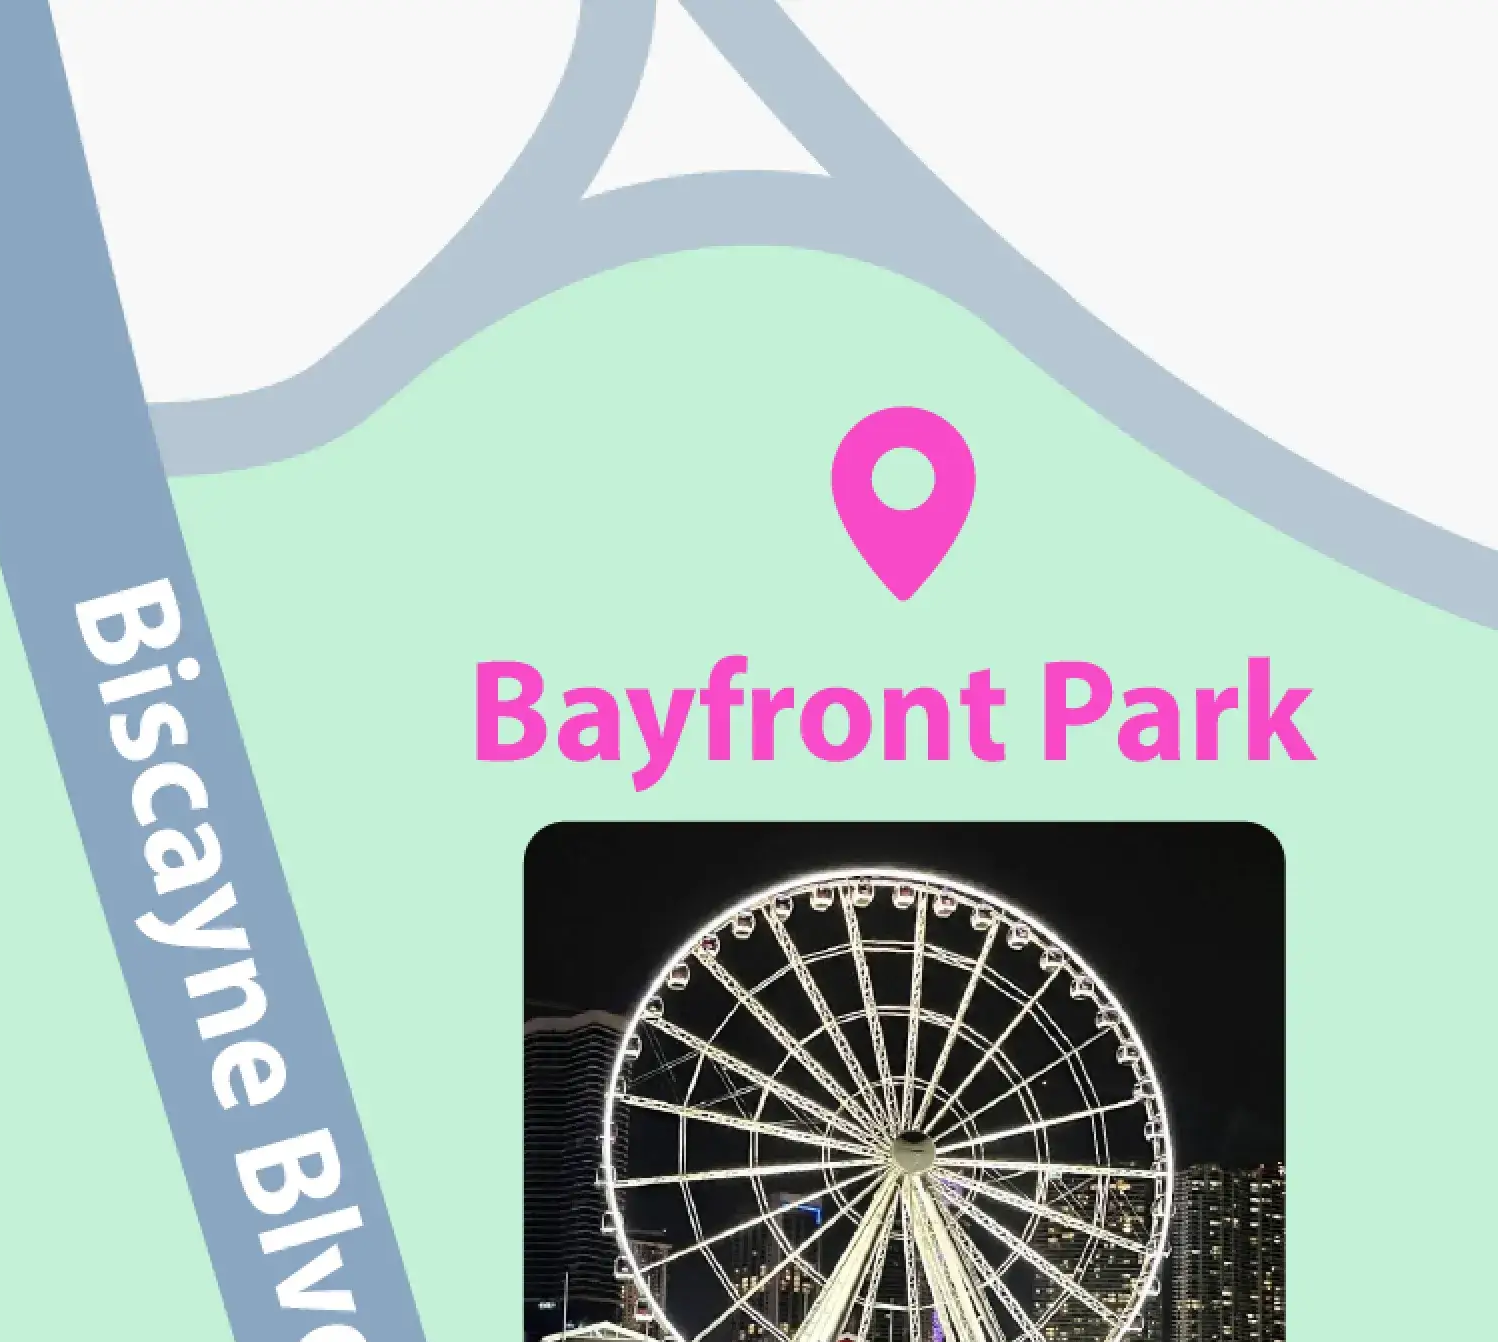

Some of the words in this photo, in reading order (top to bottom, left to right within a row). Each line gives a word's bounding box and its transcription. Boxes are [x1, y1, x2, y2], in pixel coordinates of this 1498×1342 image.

[74, 576, 288, 1111] Biscayne
[476, 654, 1007, 793] Bayfront
[1044, 656, 1318, 764] Park
